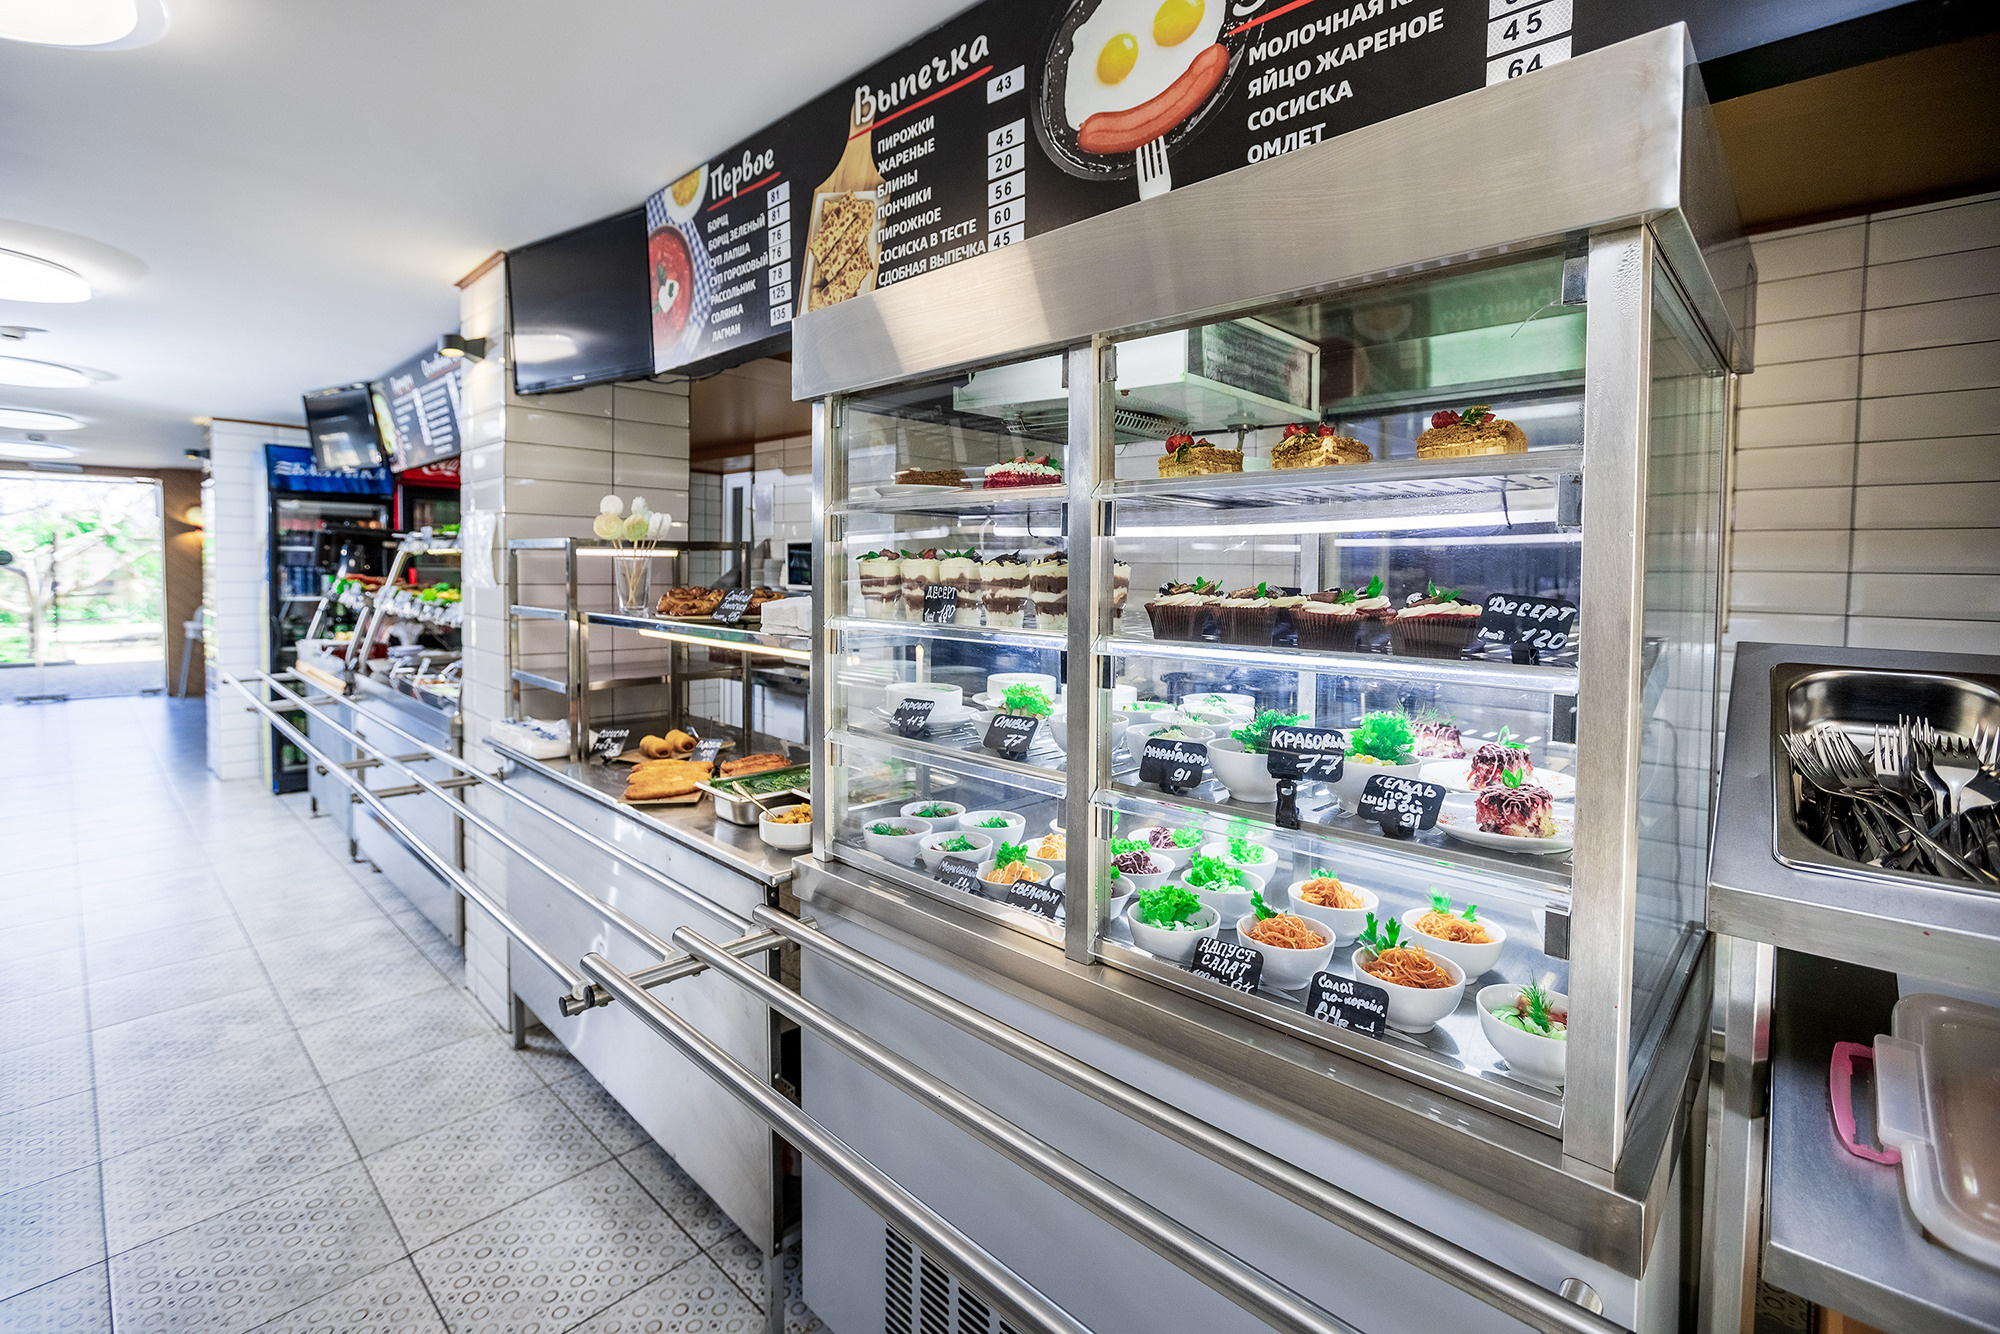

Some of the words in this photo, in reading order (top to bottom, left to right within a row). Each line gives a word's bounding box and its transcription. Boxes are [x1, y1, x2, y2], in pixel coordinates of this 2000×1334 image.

[1249, 0, 1384, 66] МОЛОЧНАЯ
[1502, 9, 1543, 41] 45
[1247, 59, 1312, 100] ЯЙЦО
[1315, 8, 1445, 75] ЖАРЕНОЕ
[1508, 53, 1543, 80] 64
[854, 34, 990, 126] Выпечка
[996, 75, 1012, 93] 43
[1247, 80, 1354, 131] СОСИСКА
[877, 115, 935, 155] ПИРОЖКИ
[996, 129, 1013, 147] 45
[1247, 122, 1327, 164] ОМЛЕТ
[877, 137, 935, 175] ЖАРЕНЫЕ
[995, 154, 1012, 174] 20
[710, 148, 775, 200] Первое
[877, 169, 918, 199] БЛИНЫ
[770, 188, 780, 203] 81
[995, 181, 1012, 200] 56
[771, 207, 781, 221] 81
[877, 186, 932, 220] ПОНЧИКИ
[707, 213, 729, 233] БОРЩ
[877, 207, 942, 243] ПИРОЖНОЕ
[994, 207, 1011, 225] 60
[708, 232, 730, 252] БОРЩ
[729, 212, 766, 242] ЗЕЛЕНЫЙ
[771, 229, 782, 243] 76
[878, 236, 929, 265] СОСИСКА
[930, 232, 939, 247] В
[940, 218, 977, 243] ТЕСТЕ
[993, 231, 1010, 248] 45
[723, 242, 751, 264] ЛАПША
[771, 246, 782, 260] 76
[878, 258, 927, 286] СДОБНАЯ
[929, 239, 987, 269] ВЫПЕЧКА
[723, 251, 769, 282] ГОРОХОВЫЙ
[772, 267, 783, 281] 78
[710, 278, 756, 306] РАССОЛЬНИК
[772, 285, 786, 300] 125
[711, 303, 744, 324] СОЛЯНКА
[773, 307, 786, 321] 135
[712, 323, 741, 342] ЛАГМАН
[925, 585, 957, 600] ДЕСЕРТ
[1522, 628, 1568, 650] 120
[1002, 734, 1028, 748] 77
[1173, 767, 1192, 781] 91
[1296, 754, 1343, 775] 77
[1400, 812, 1421, 829] 91
[1198, 938, 1257, 962] КАПУСТ
[1201, 954, 1252, 979] САЛАТ
